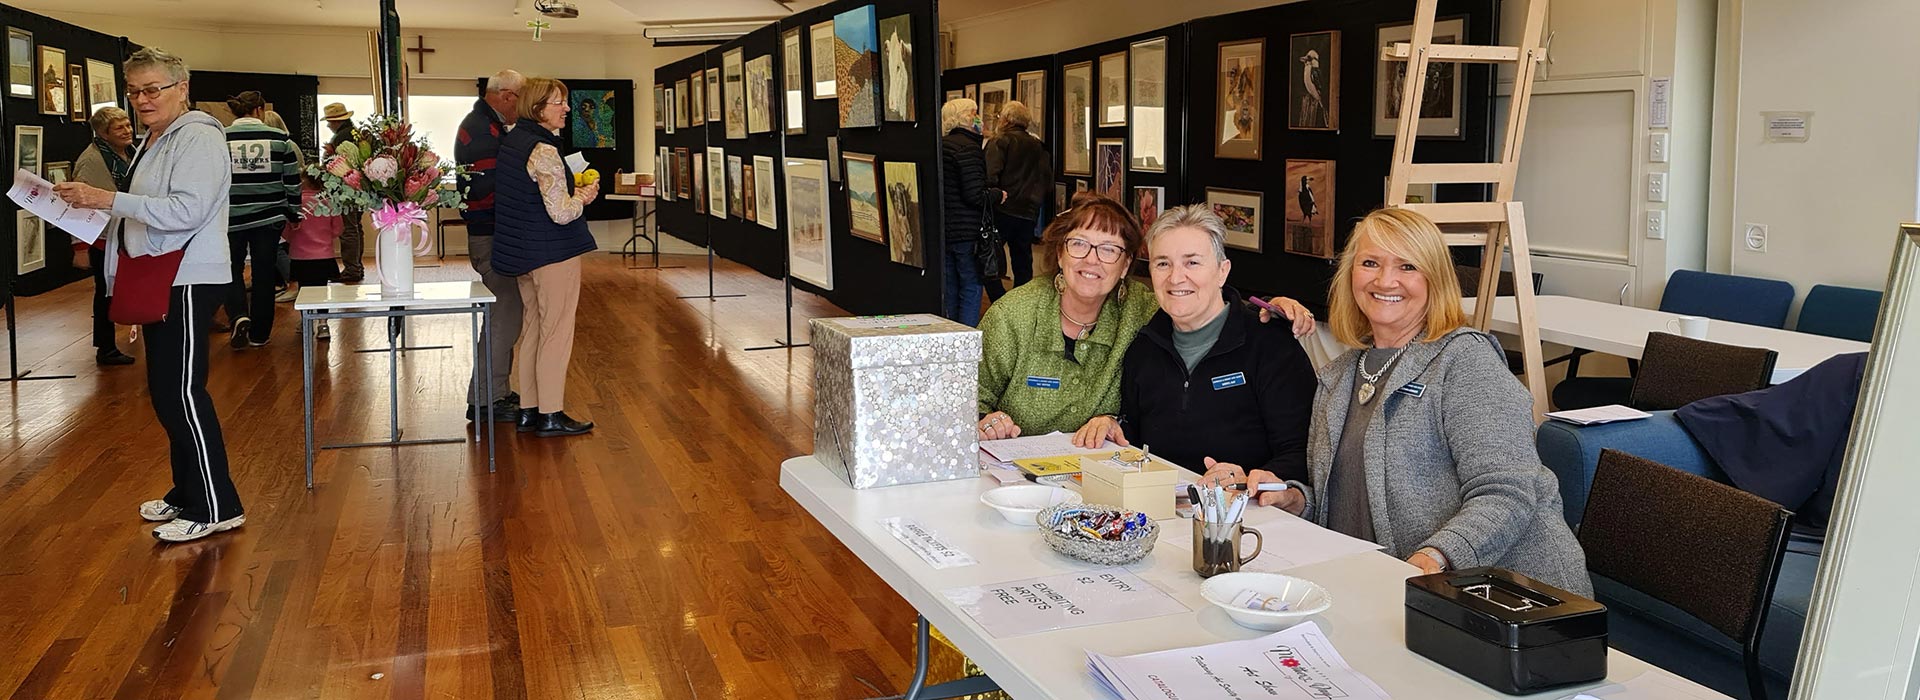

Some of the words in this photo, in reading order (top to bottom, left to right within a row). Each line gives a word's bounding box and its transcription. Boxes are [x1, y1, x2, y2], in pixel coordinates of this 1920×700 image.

[237, 143, 264, 169] 12
[1077, 576, 1095, 585] $2
[1099, 573, 1136, 593] ENTRY
[990, 588, 1020, 606] FREE
[1011, 586, 1052, 611] ARTISTS
[1032, 582, 1085, 616] EXHIBITING
[1238, 666, 1259, 677] Art
[1255, 680, 1278, 695] Show
